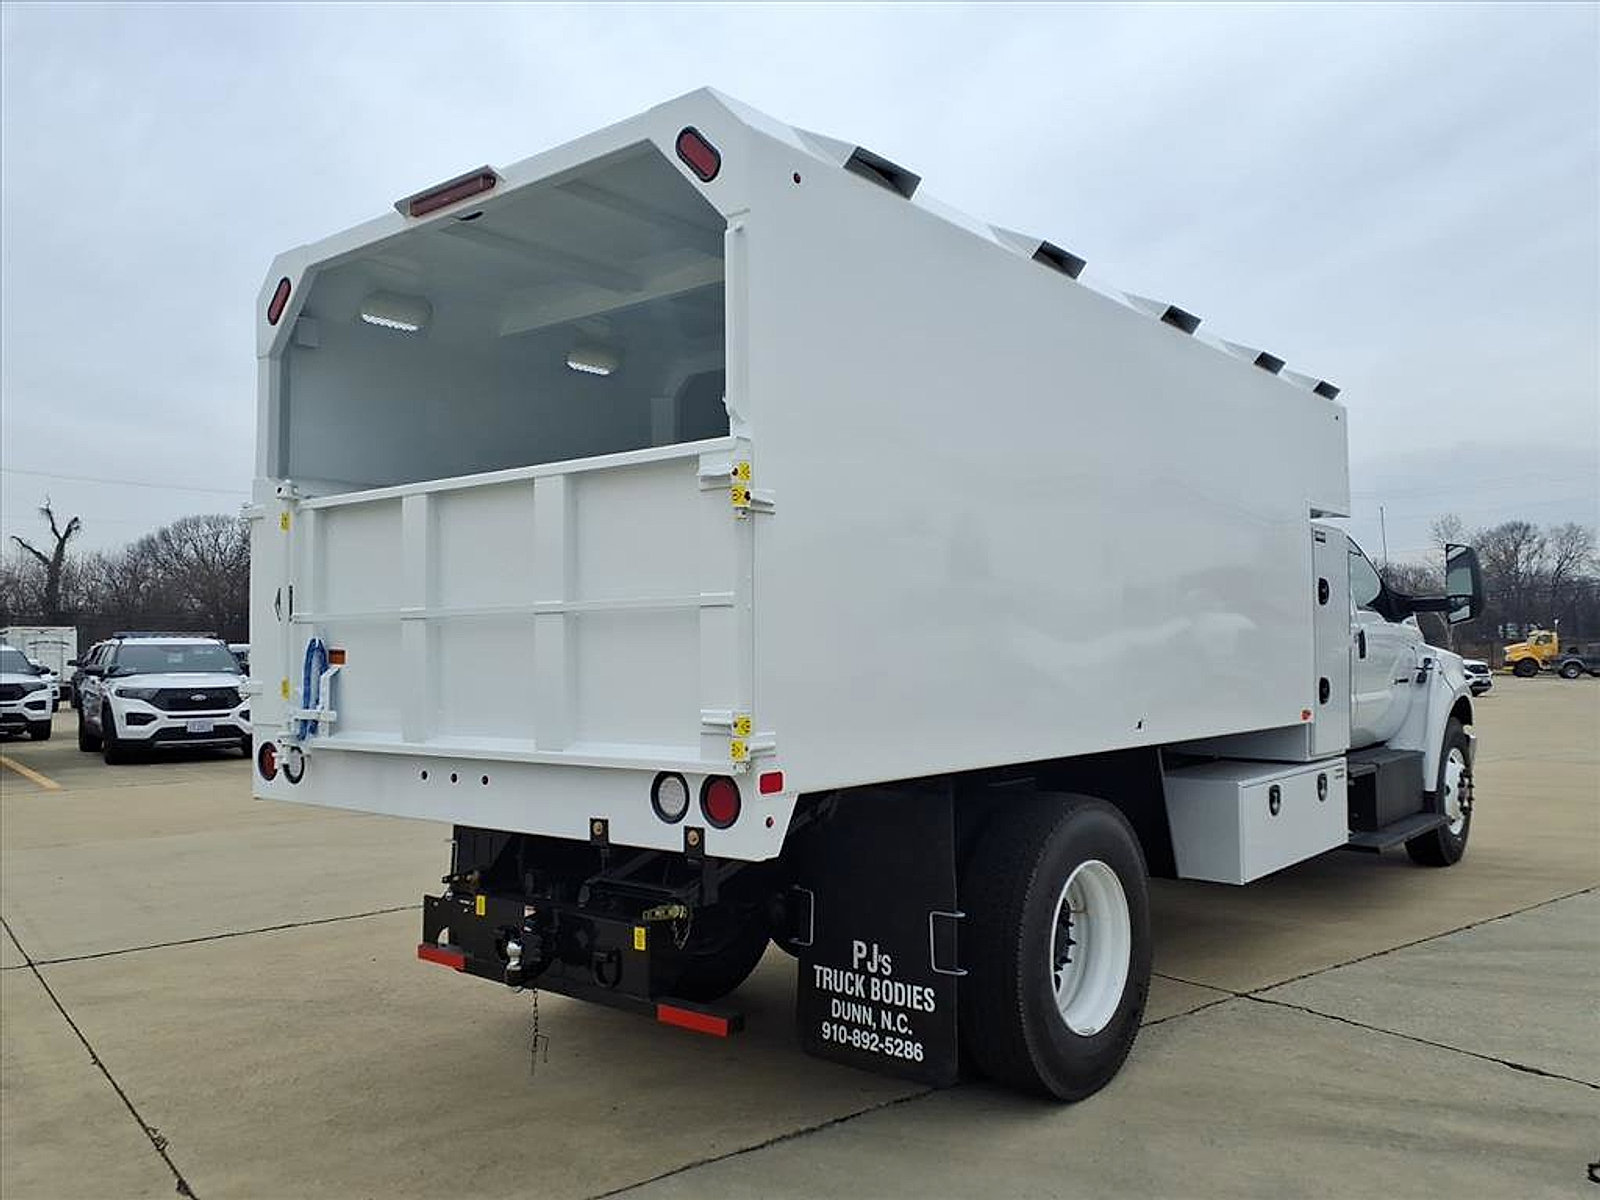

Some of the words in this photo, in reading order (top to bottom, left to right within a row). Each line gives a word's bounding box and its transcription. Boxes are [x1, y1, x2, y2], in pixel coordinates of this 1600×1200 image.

[853, 940, 892, 976] PJ's
[813, 964, 866, 998] TRUCK
[870, 977, 936, 1013] BODIES
[831, 998, 877, 1031] DUNN,
[881, 1010, 913, 1035] N.C.
[821, 1021, 924, 1062] 910-892-5286
